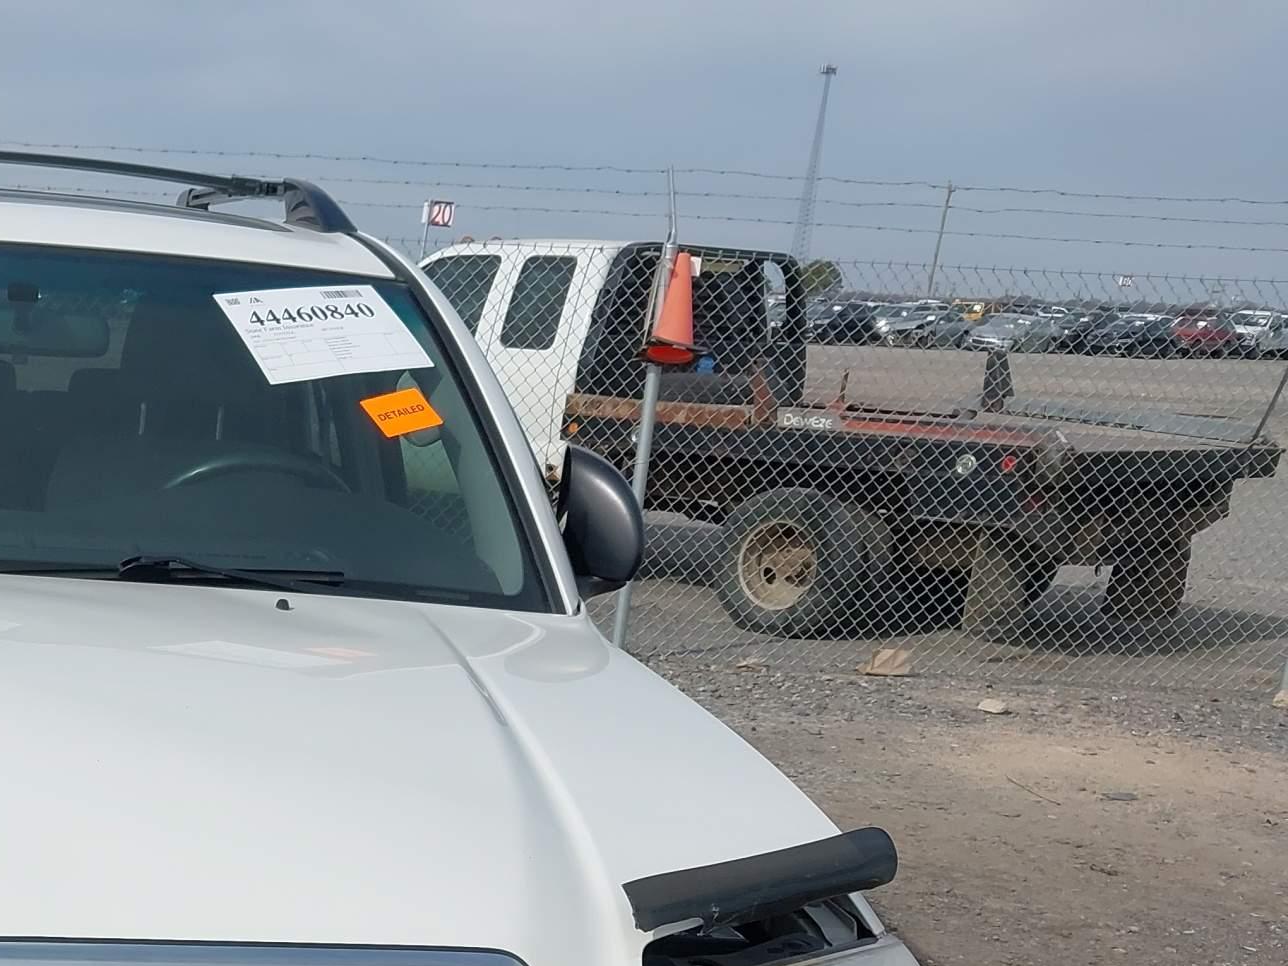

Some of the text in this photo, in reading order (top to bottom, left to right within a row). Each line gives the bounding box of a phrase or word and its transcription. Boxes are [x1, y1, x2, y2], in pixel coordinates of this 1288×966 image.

[430, 203, 453, 226] 20
[249, 302, 376, 327] 44460840
[377, 403, 425, 422] DETAILED
